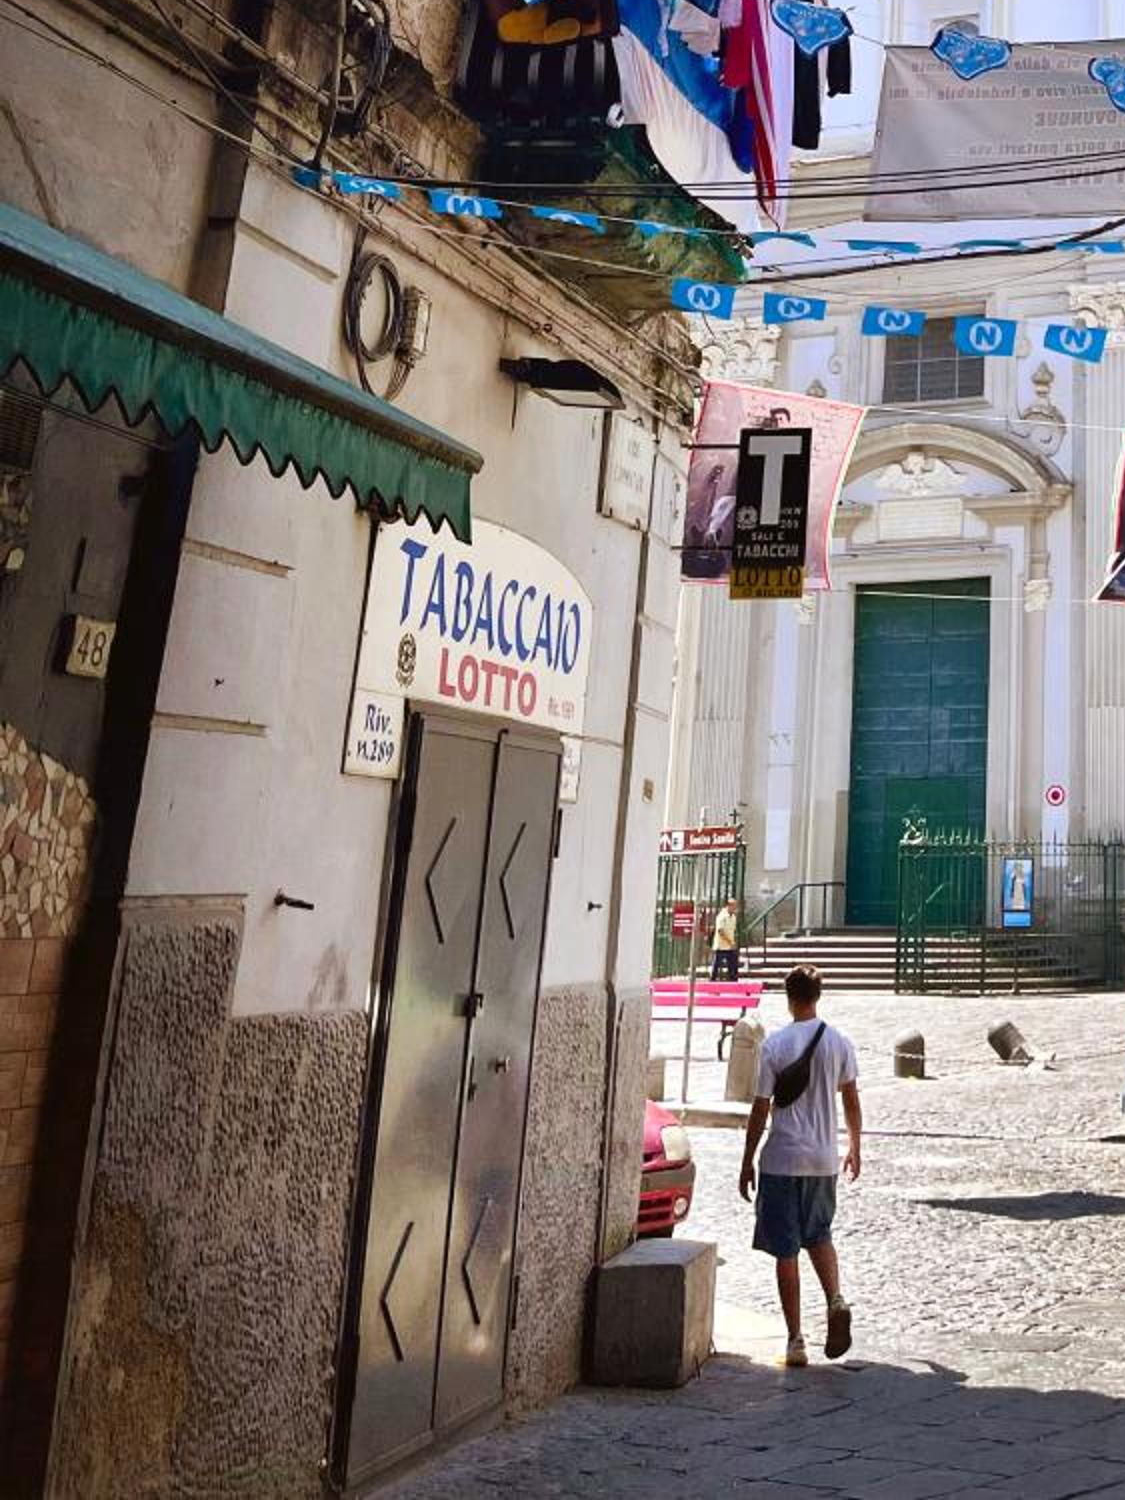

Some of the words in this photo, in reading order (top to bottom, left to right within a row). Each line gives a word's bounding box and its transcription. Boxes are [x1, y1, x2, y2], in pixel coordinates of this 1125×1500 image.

[748, 435, 803, 526] T
[736, 544, 799, 558] TABACCHI
[734, 565, 802, 587] LOTTO
[400, 538, 581, 674] TABACCAIO
[77, 626, 107, 667] 48
[438, 647, 537, 717] LOTTO
[363, 703, 393, 736] Riv.
